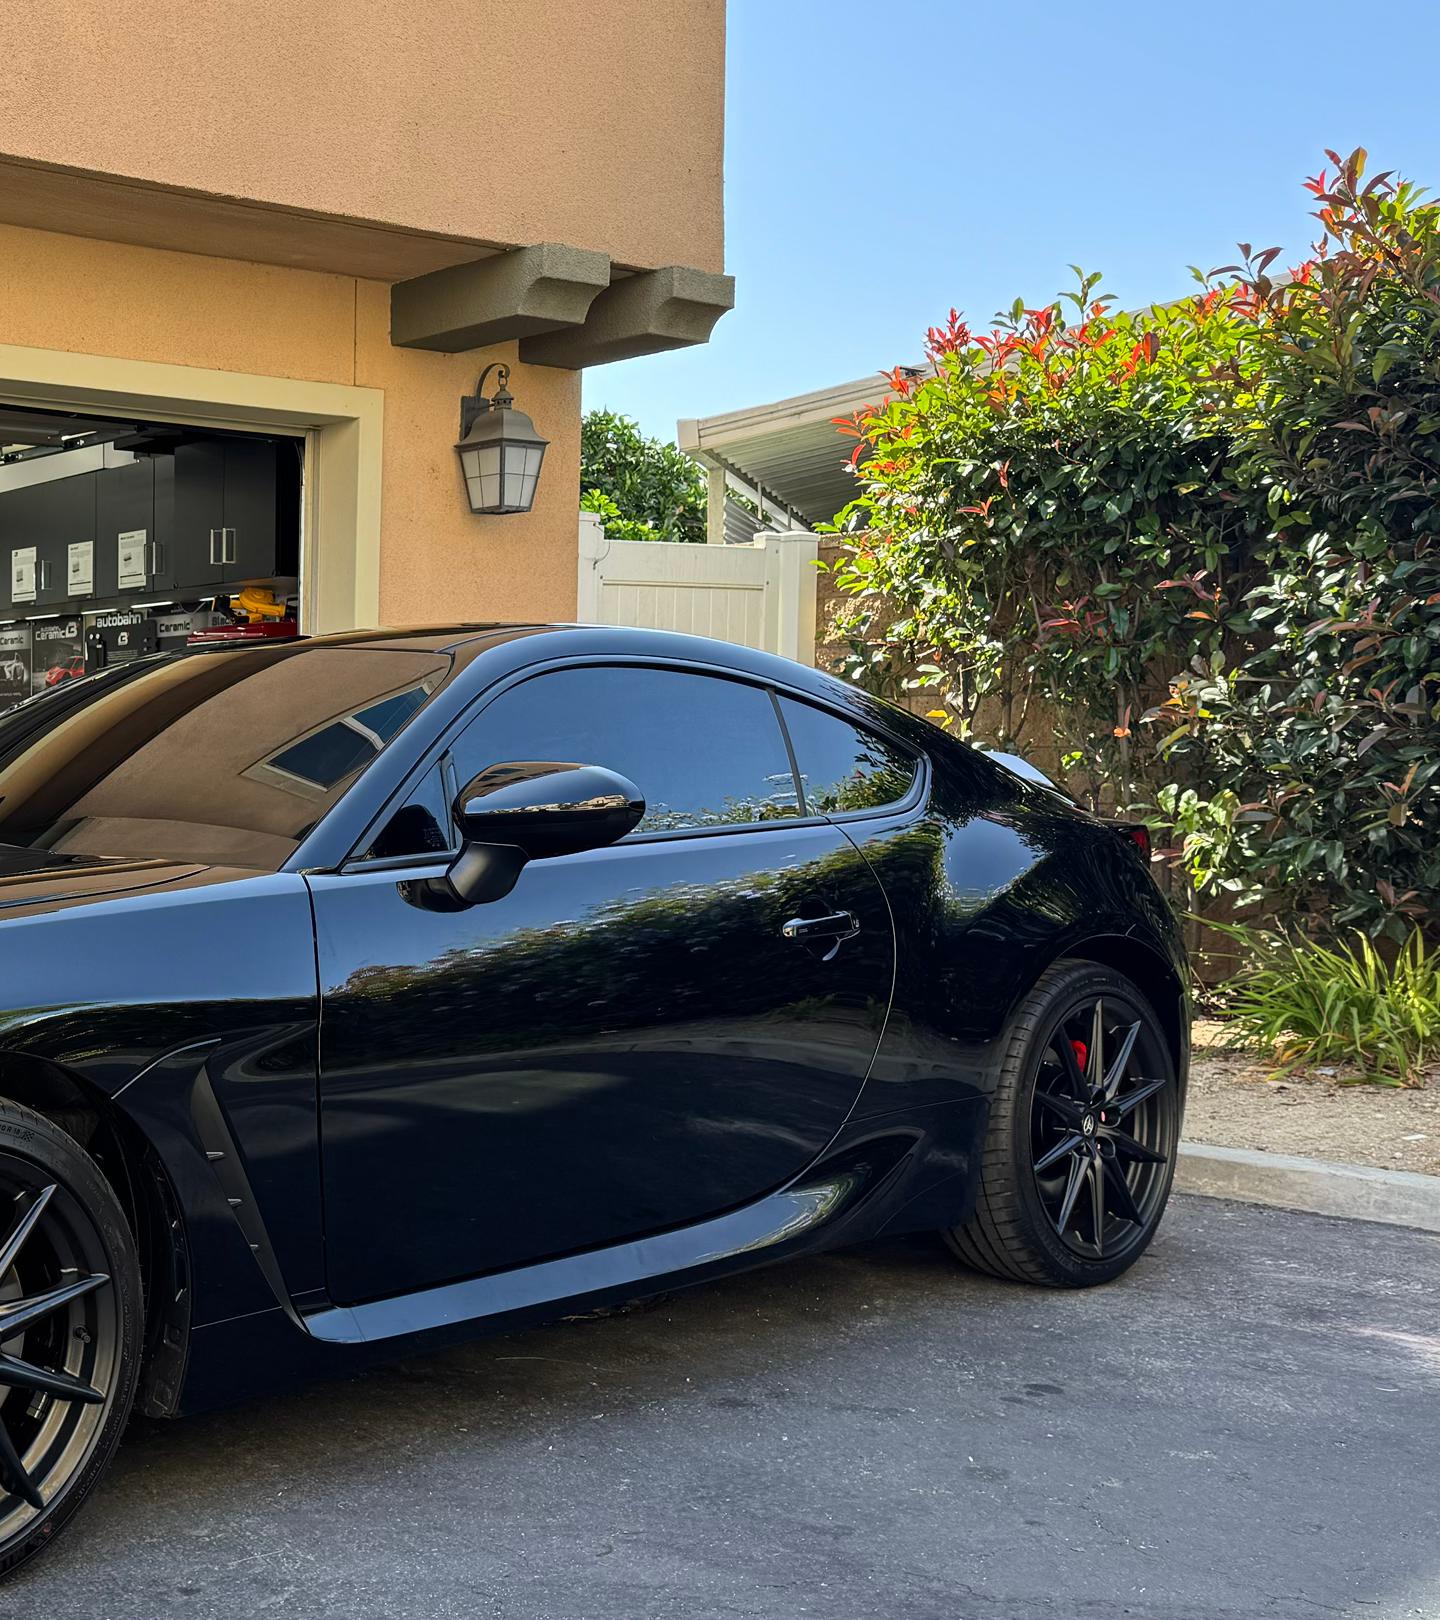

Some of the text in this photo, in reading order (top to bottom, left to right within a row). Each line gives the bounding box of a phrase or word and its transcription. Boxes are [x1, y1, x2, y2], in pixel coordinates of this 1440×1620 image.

[96, 612, 141, 628] autobahn
[159, 622, 190, 632] Ceramic
[0, 636, 24, 646] Ceramic
[35, 631, 65, 641] Ceramic
